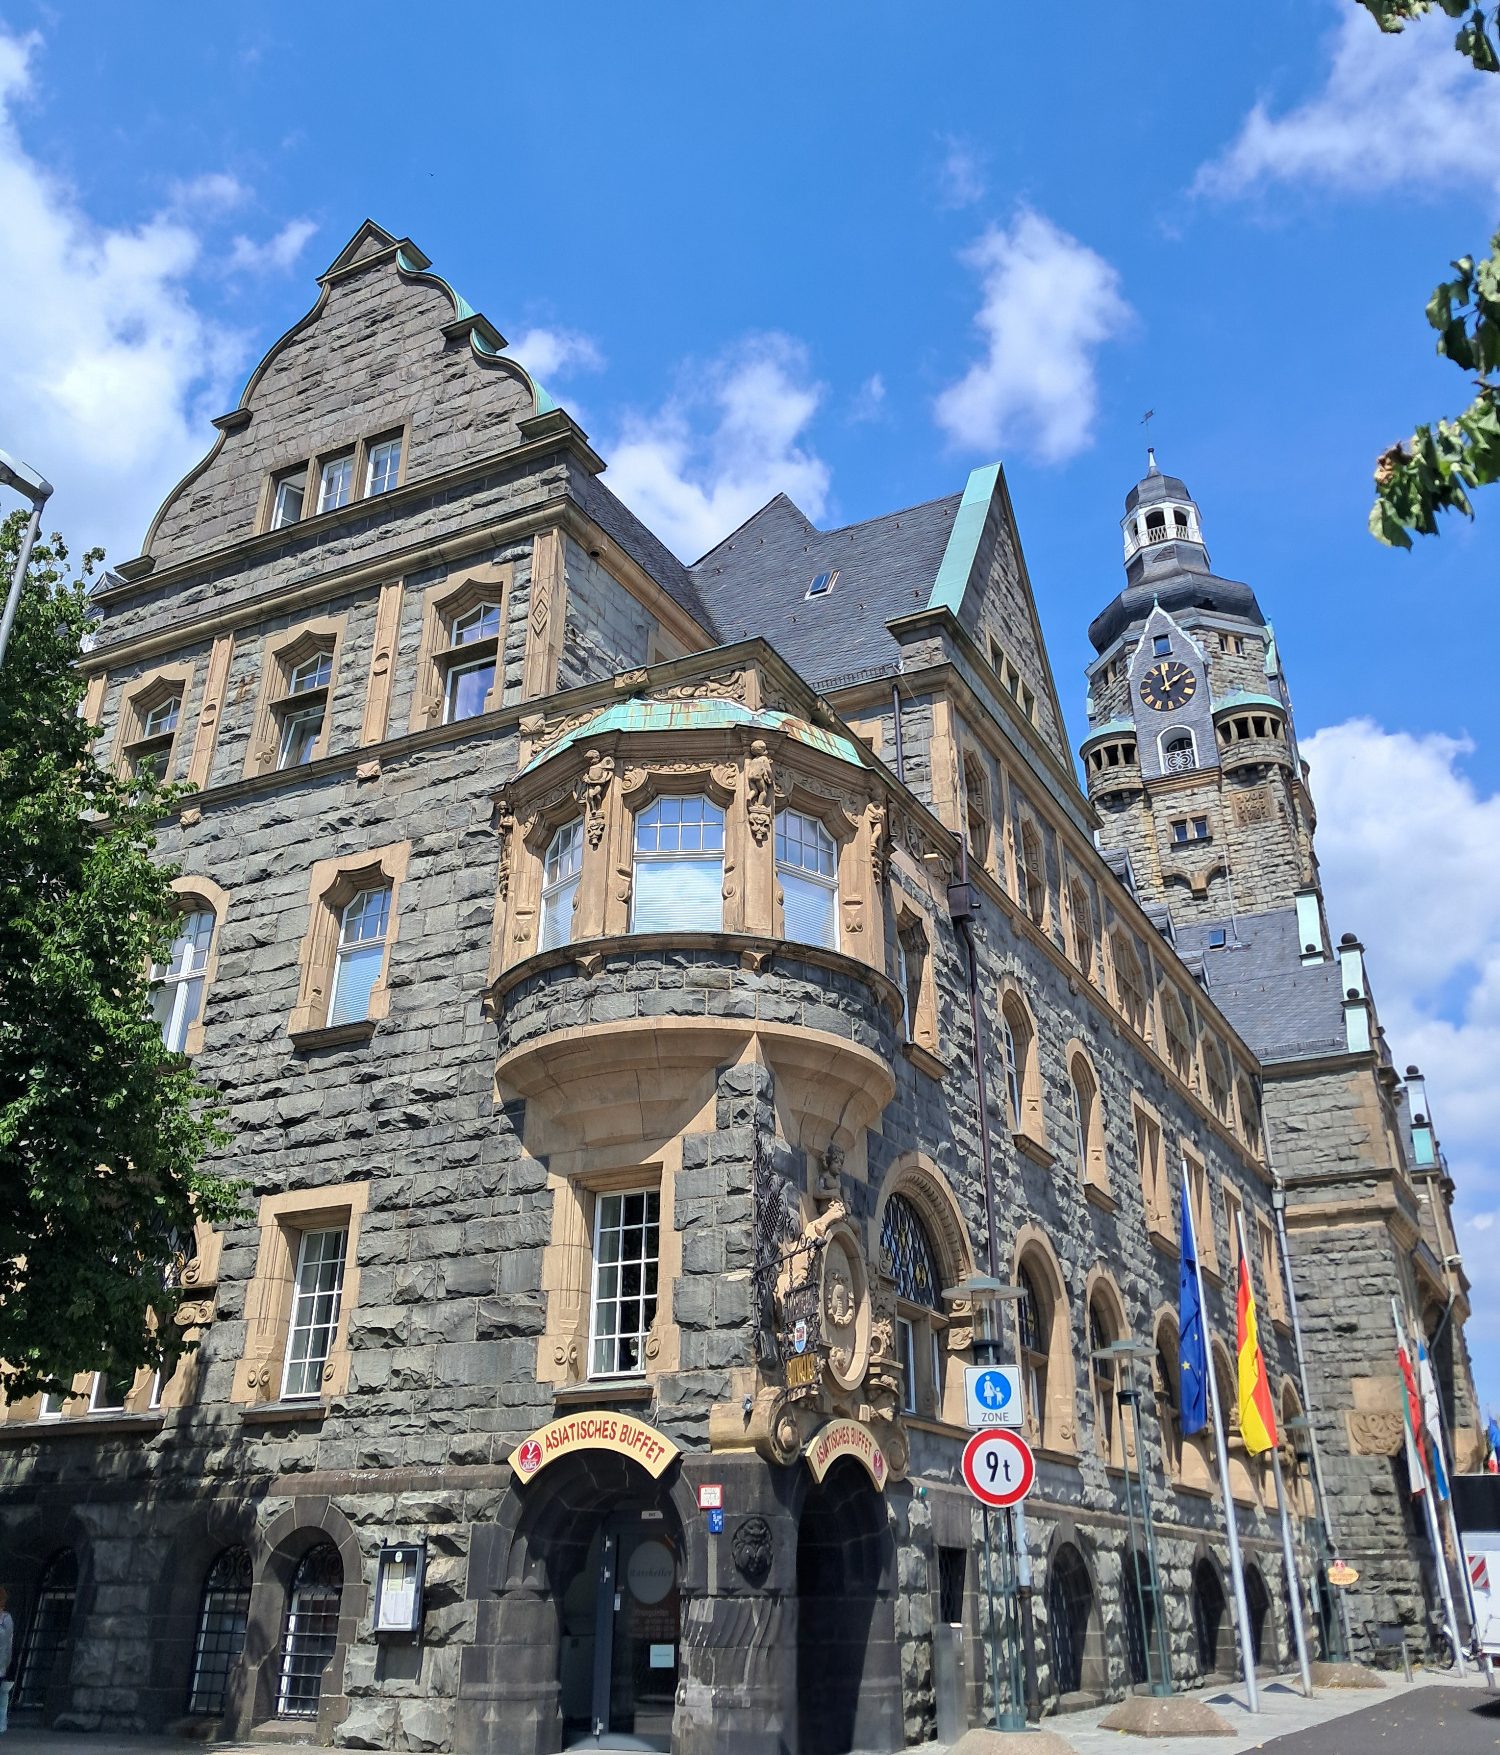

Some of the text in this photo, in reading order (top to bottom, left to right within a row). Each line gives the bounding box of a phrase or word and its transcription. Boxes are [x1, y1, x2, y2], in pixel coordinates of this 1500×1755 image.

[981, 1412, 1009, 1422] ZONE
[545, 1419, 666, 1464] ASIATISCHES BUFFET
[816, 1425, 872, 1469] ASIATISCHES BUFFET
[985, 1451, 1012, 1483] 9 t
